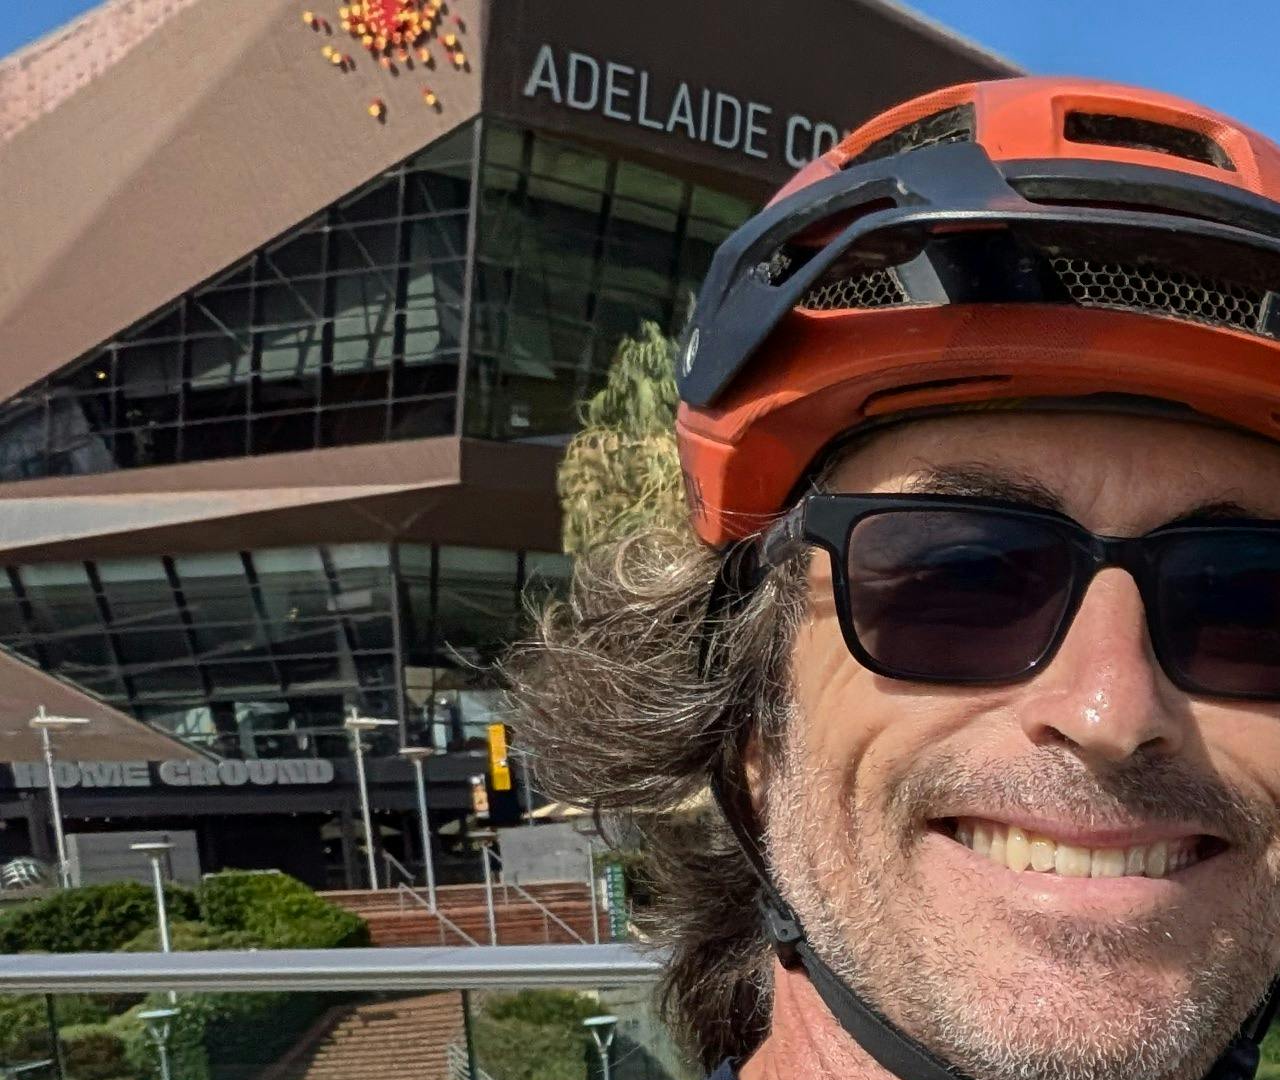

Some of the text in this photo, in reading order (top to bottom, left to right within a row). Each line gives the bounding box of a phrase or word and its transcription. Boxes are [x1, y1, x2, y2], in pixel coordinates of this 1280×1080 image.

[523, 44, 851, 168] ADELAIDE CO
[11, 758, 335, 788] HOME GROUND
